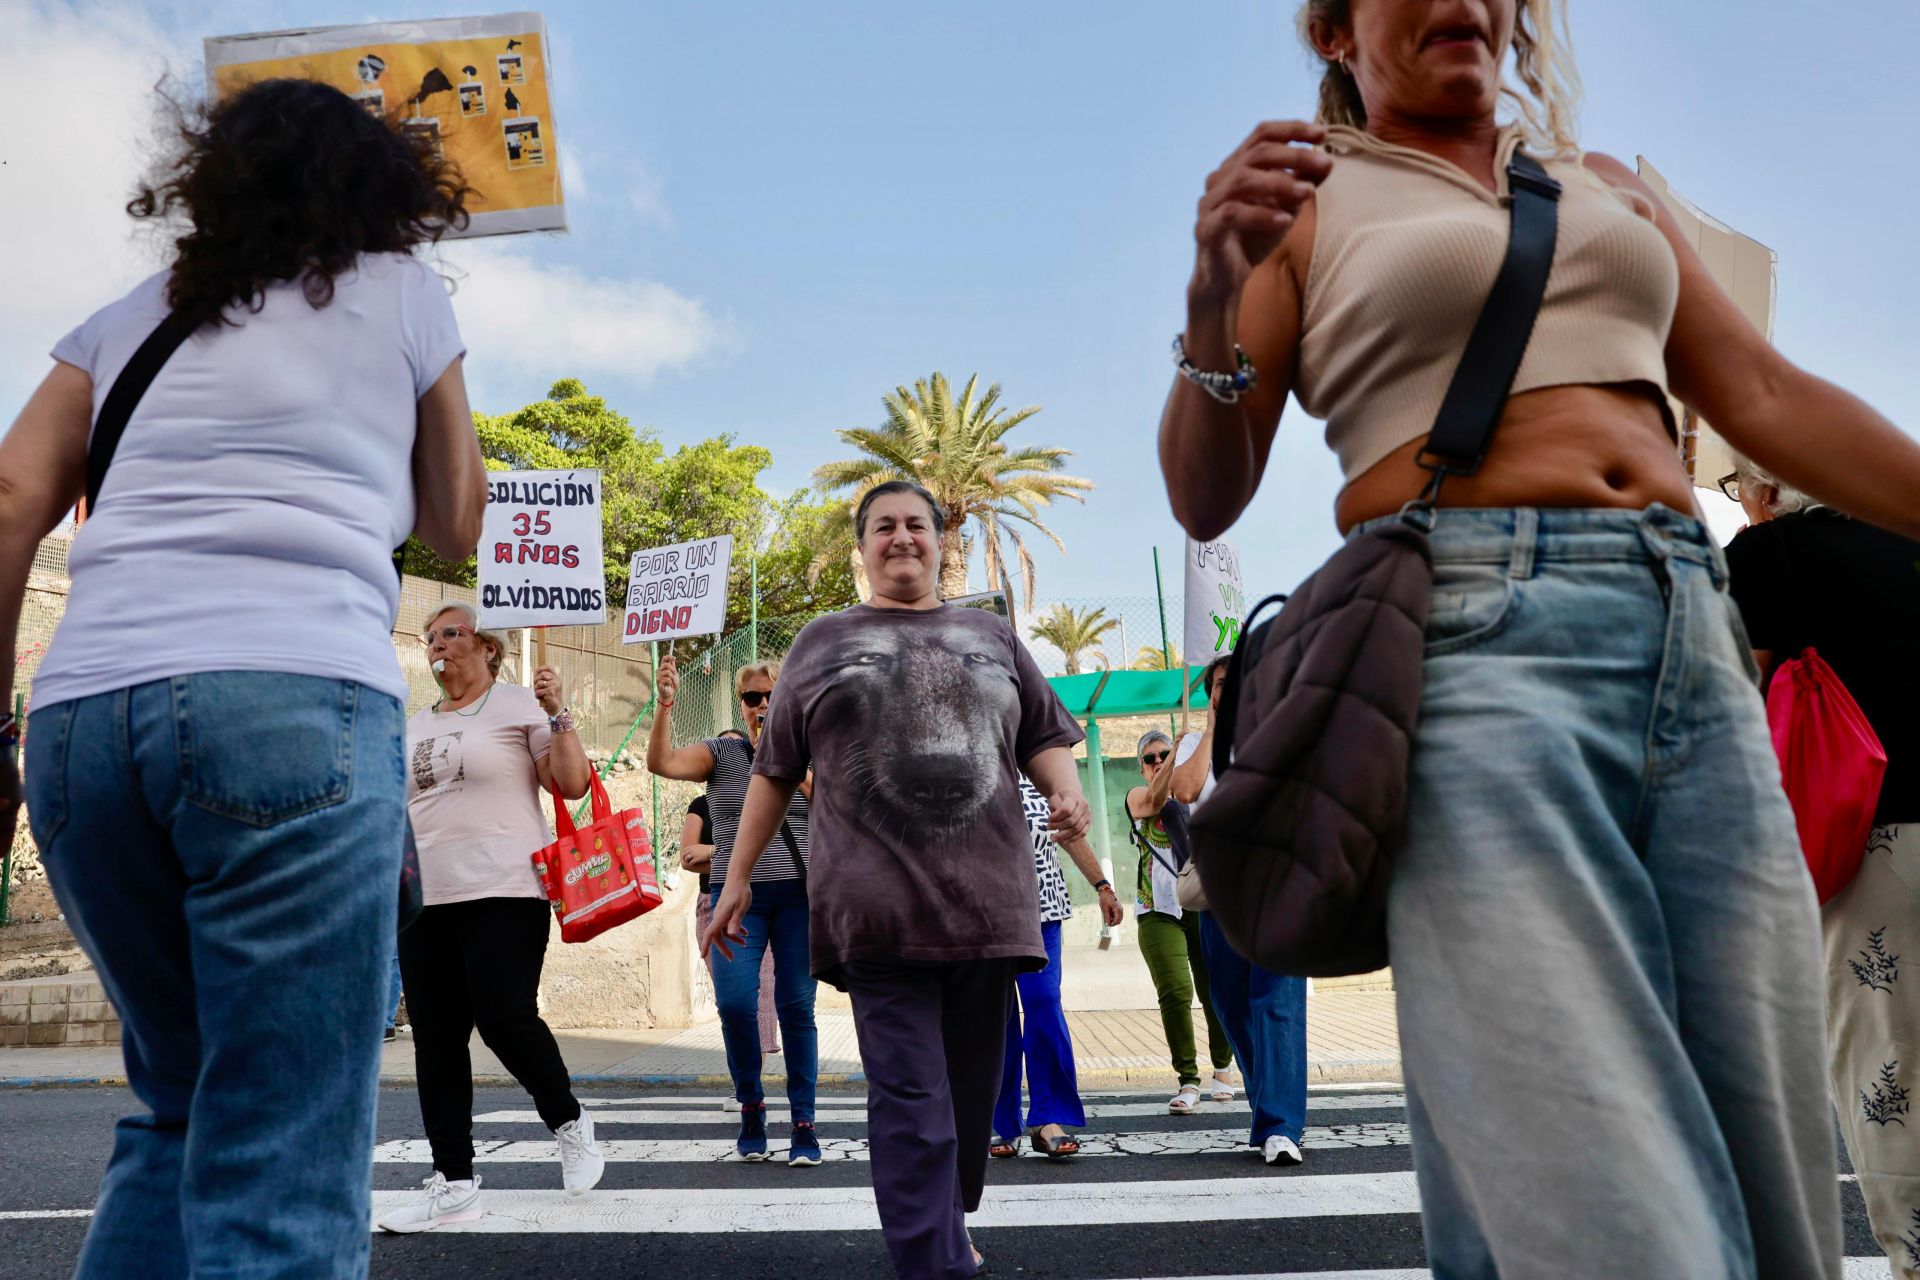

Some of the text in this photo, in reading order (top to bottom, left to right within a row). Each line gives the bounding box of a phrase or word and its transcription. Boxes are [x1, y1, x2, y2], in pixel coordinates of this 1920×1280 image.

[512, 510, 552, 536] 35
[494, 538, 580, 568] AÑOS
[685, 541, 717, 570] UN
[482, 579, 602, 611] OLVIDADOS
[628, 572, 710, 606] BARRIO
